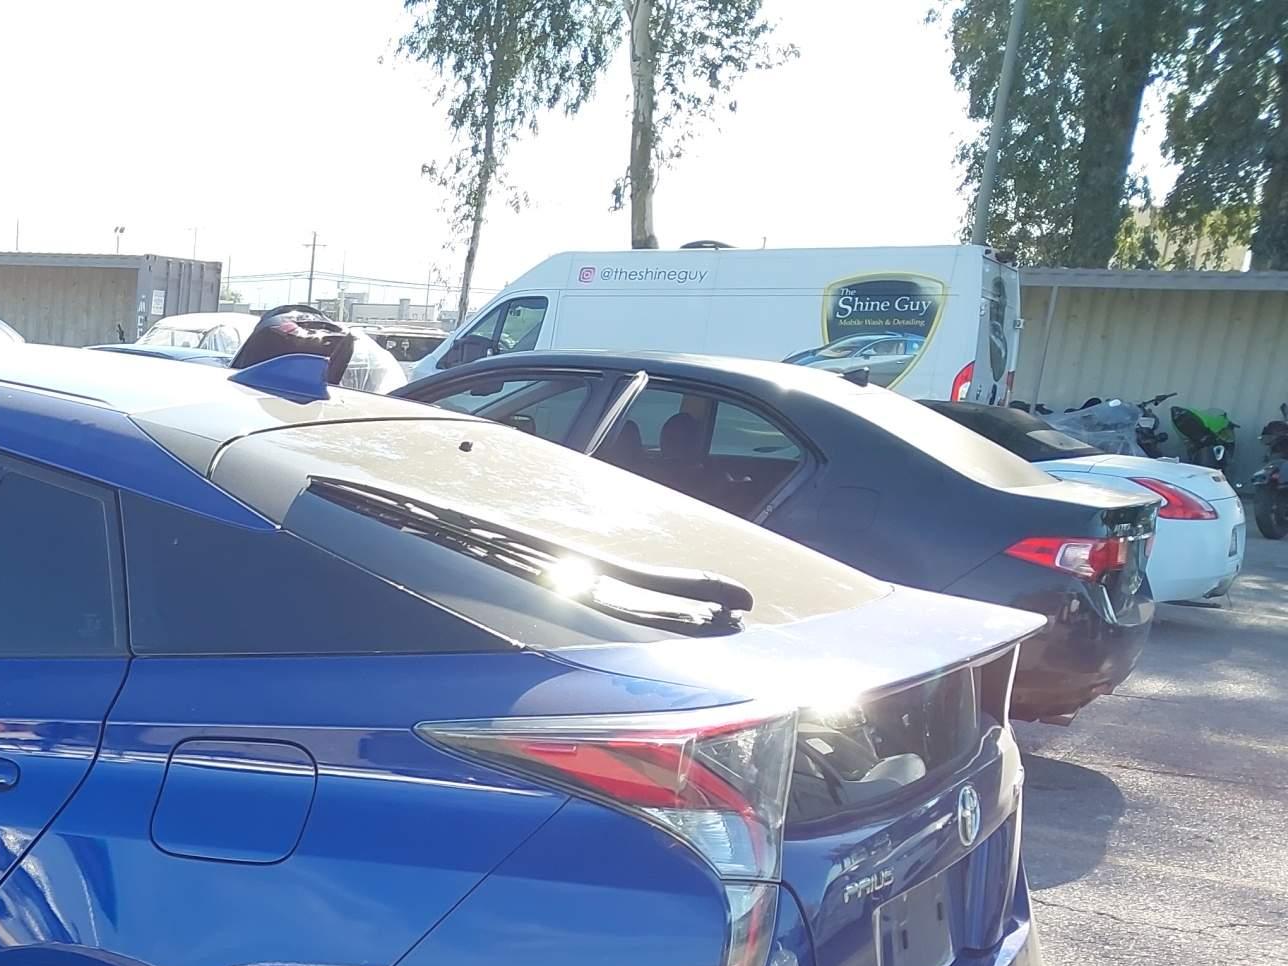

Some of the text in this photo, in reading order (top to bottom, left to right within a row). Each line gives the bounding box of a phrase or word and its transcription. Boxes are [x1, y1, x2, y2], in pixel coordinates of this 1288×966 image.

[600, 267, 708, 283] @theshineguy
[840, 287, 856, 296] The
[835, 296, 932, 318] Shine Guy
[839, 318, 925, 327] Mobile Wash & Detailing
[843, 869, 895, 904] PRIUS
